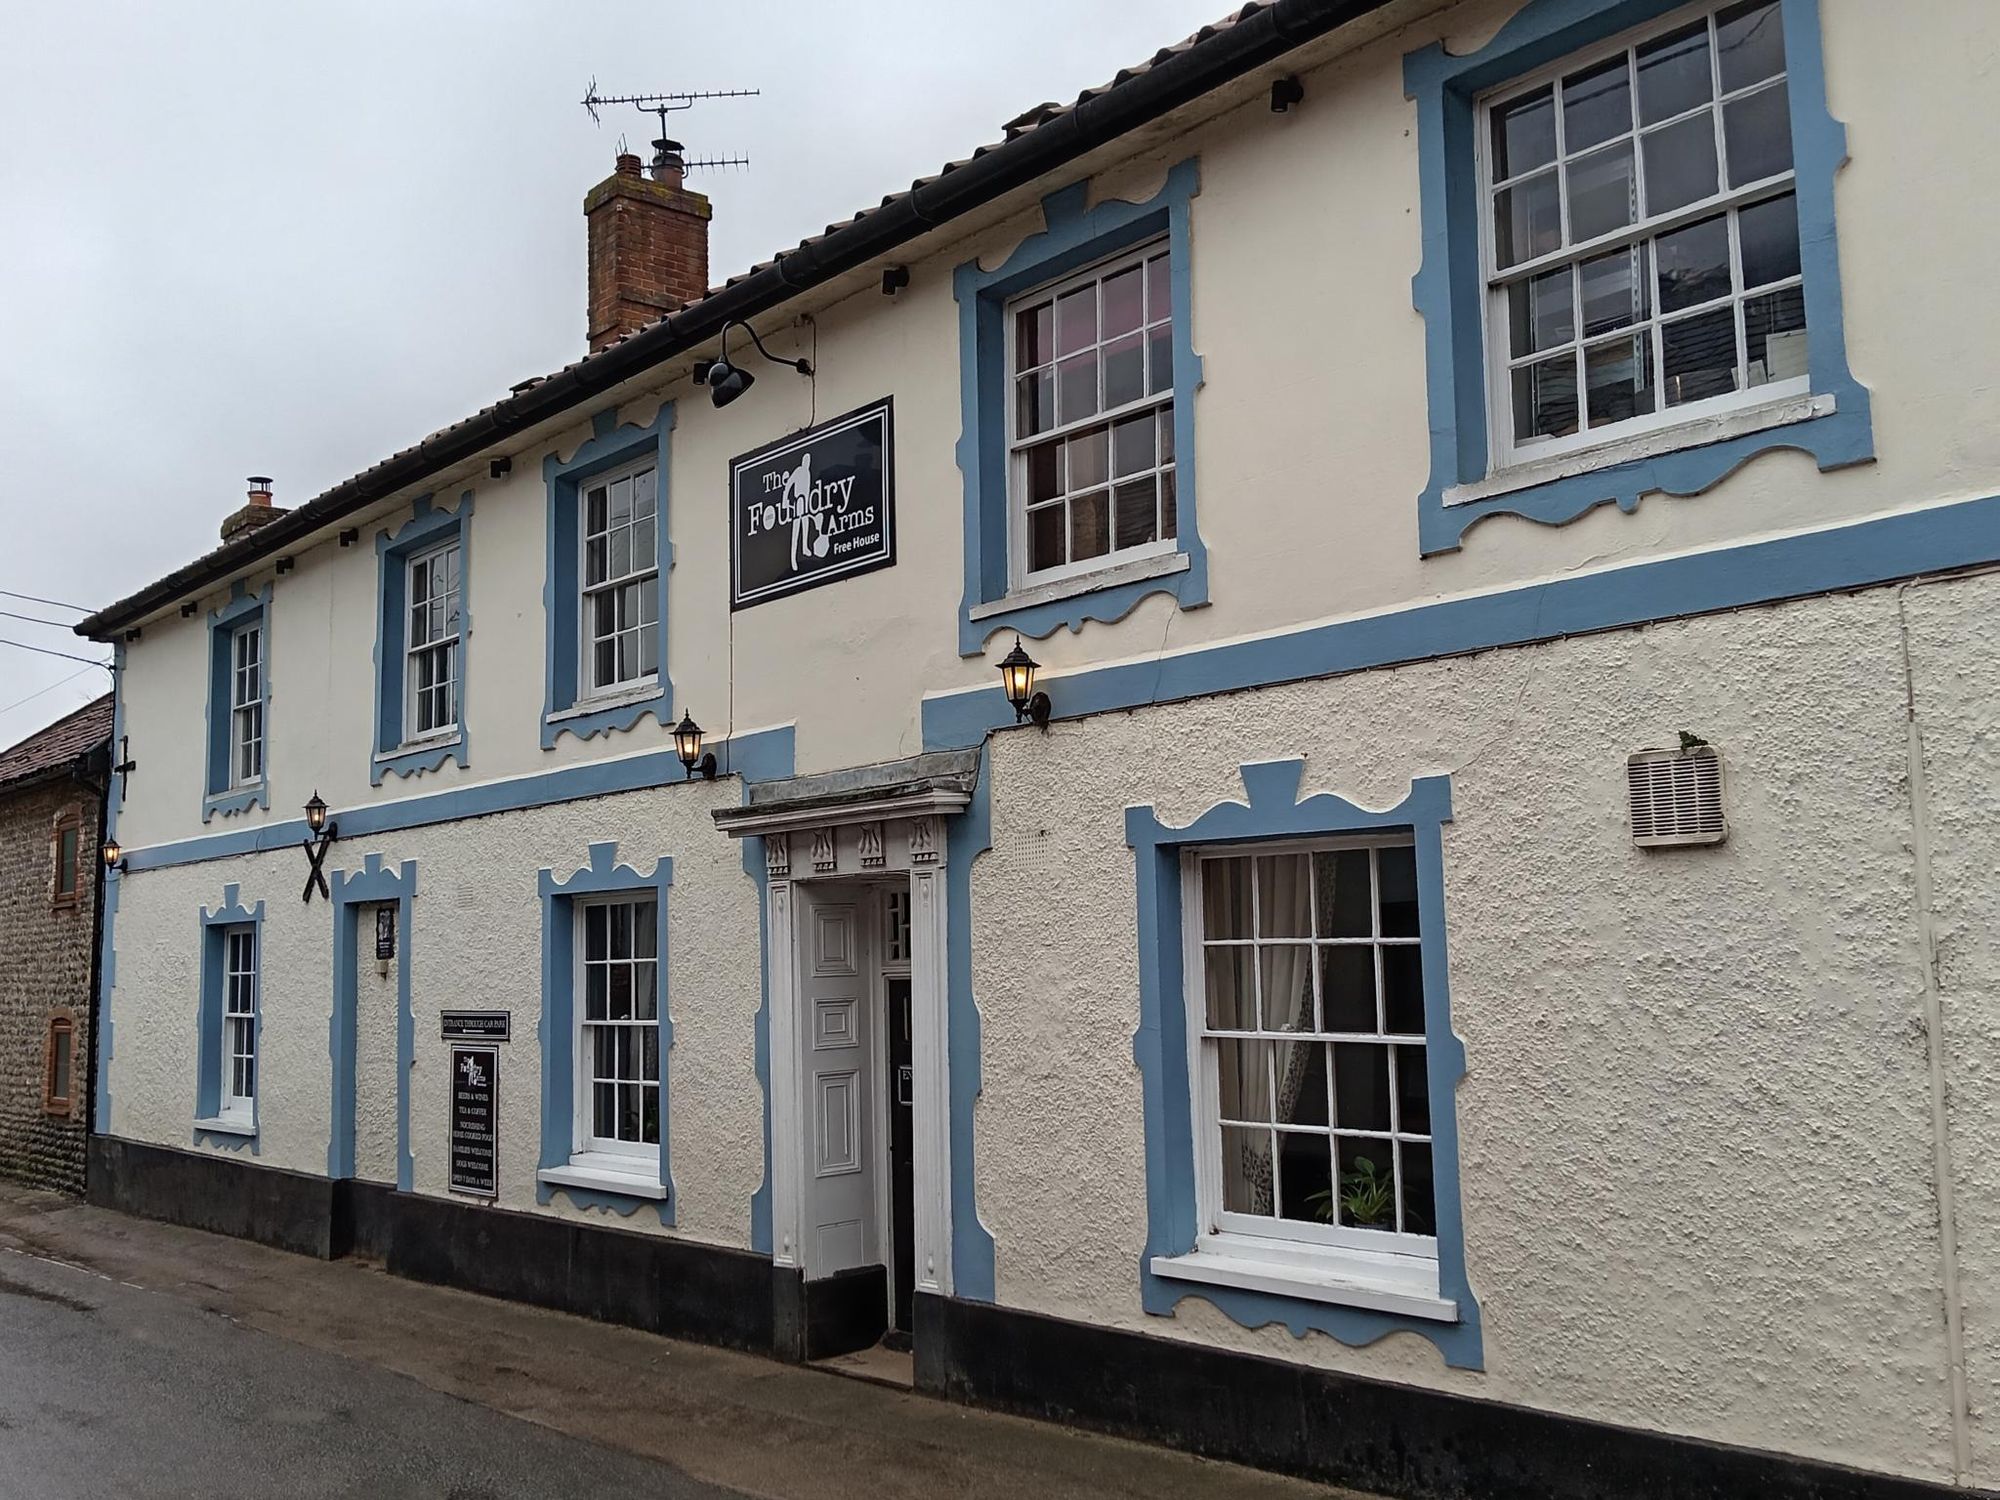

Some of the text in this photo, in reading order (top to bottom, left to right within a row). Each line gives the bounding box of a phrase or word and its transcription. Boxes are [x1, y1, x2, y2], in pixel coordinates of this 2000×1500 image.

[763, 470, 790, 493] The
[747, 475, 856, 536] Foundry
[827, 505, 875, 536] Arms
[833, 532, 880, 555] Free House
